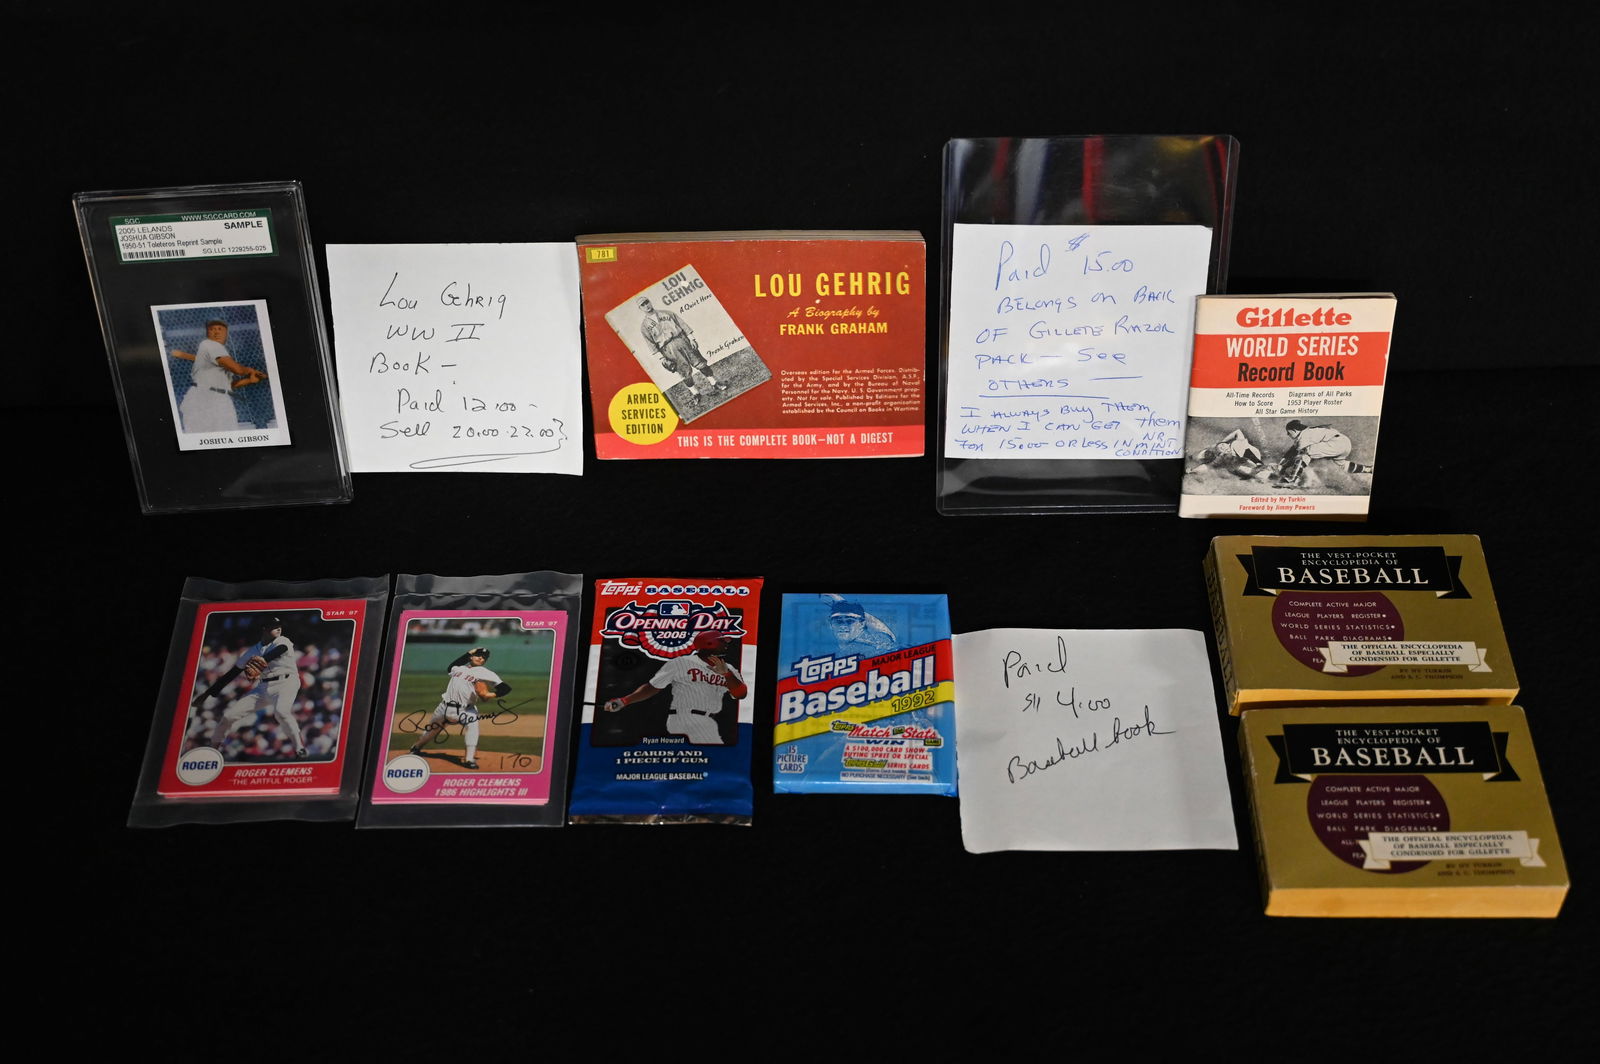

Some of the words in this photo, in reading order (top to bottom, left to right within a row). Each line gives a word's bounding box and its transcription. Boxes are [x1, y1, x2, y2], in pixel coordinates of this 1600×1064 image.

[181, 211, 257, 221] WWW.SGCCARD.COM
[224, 221, 263, 229] SAMPLE
[120, 234, 147, 242] JOSHUA
[177, 239, 199, 247] Reprint
[200, 238, 222, 246] Sample
[596, 250, 609, 258] 781
[995, 240, 1051, 291] Paid
[1083, 251, 1134, 275] 15.00
[662, 271, 687, 292] LOU
[755, 273, 802, 298] LOU
[815, 271, 910, 297] GEHRIG
[380, 272, 418, 310] Lou
[661, 278, 705, 306] GEHRIG
[684, 300, 700, 311] Quiet
[787, 307, 801, 318] A
[805, 306, 863, 320] Biography
[867, 305, 880, 318] by
[1236, 306, 1353, 328] Gillette
[445, 324, 485, 343] II
[779, 323, 825, 336] FRANK
[830, 322, 888, 335] GRAHAM
[976, 328, 1008, 344] OF
[1226, 337, 1288, 358] WORLD
[1297, 335, 1360, 357] SERIES
[975, 354, 1034, 370] PACK
[1237, 362, 1296, 383] Record
[1303, 361, 1346, 381] Book
[398, 388, 444, 414] Paid
[627, 393, 660, 405] ARMED
[621, 408, 666, 420] SERVICES
[380, 421, 431, 439] Sell
[626, 423, 664, 435] EDITION
[962, 424, 1011, 435] WHEN
[1018, 421, 1031, 431] I
[1045, 423, 1080, 431] CAN
[1092, 421, 1121, 430] GET
[238, 435, 270, 443] GIBSON
[677, 435, 699, 447] THIS
[703, 435, 713, 447] IS
[717, 434, 735, 447] THE
[739, 433, 787, 446] COMPLETE
[850, 433, 856, 444] A
[860, 431, 894, 443] DIGEST
[1277, 567, 1429, 585] BASEBALL
[645, 585, 750, 596] BASEBALL
[614, 612, 688, 630] OPENING
[690, 612, 735, 630] DAY
[656, 631, 687, 639] 2008
[872, 654, 902, 667] MAJOR
[903, 644, 937, 660] LEAGUE
[1003, 636, 1067, 688] Paid
[780, 654, 936, 723] Baseball
[892, 690, 936, 713] 1992
[1057, 687, 1111, 718] 4.00
[848, 726, 891, 738] Match
[902, 727, 937, 738] Stats
[1336, 729, 1358, 737] THE
[643, 737, 659, 745] Ryan
[1338, 737, 1421, 745] ENCYCLOPEDIA
[788, 745, 797, 755] 15
[1310, 746, 1475, 766] BASEBALL
[501, 753, 532, 769] 170
[776, 754, 807, 764] PICTURE
[1008, 732, 1100, 784] Baseball
[182, 761, 219, 771] ROGER
[235, 768, 267, 778] ROGER
[269, 767, 314, 777] CLEMENS
[779, 763, 803, 773] CARDS
[387, 769, 423, 778] ROGER
[250, 777, 282, 785] ARTFUL
[443, 779, 476, 787] ROGER
[477, 778, 522, 787] CLEMENS
[435, 788, 457, 796] 1986
[459, 788, 515, 796] HIGHLIGHTS
[518, 788, 528, 796] III
